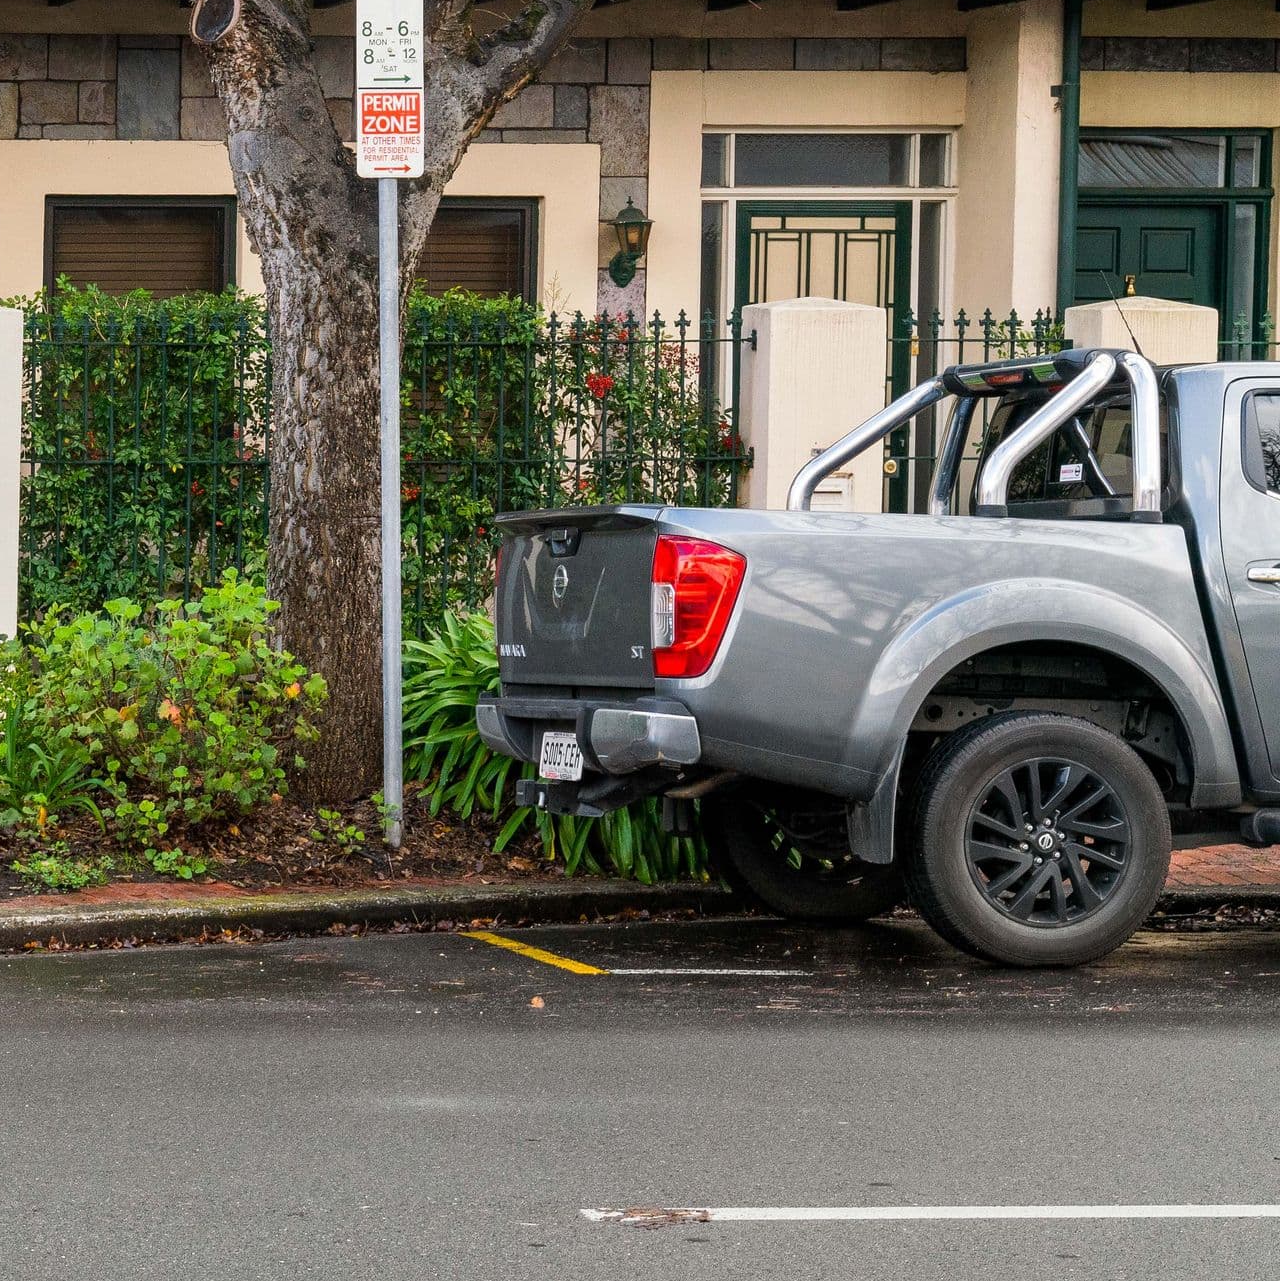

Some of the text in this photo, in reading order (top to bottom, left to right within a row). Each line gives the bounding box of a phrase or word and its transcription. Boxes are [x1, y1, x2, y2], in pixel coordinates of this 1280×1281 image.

[361, 20, 373, 37] 8
[397, 20, 409, 37] 6
[368, 38, 388, 46] MON
[399, 38, 412, 46] FRI
[402, 47, 417, 59] 12
[363, 94, 418, 112] PERMIT
[363, 115, 419, 133] ZONE
[361, 136, 421, 145] AT OTHER TIMES
[362, 146, 420, 154] FOR RESIDENTIAL
[363, 154, 409, 162] PERMIT AREA
[630, 645, 645, 659] ST
